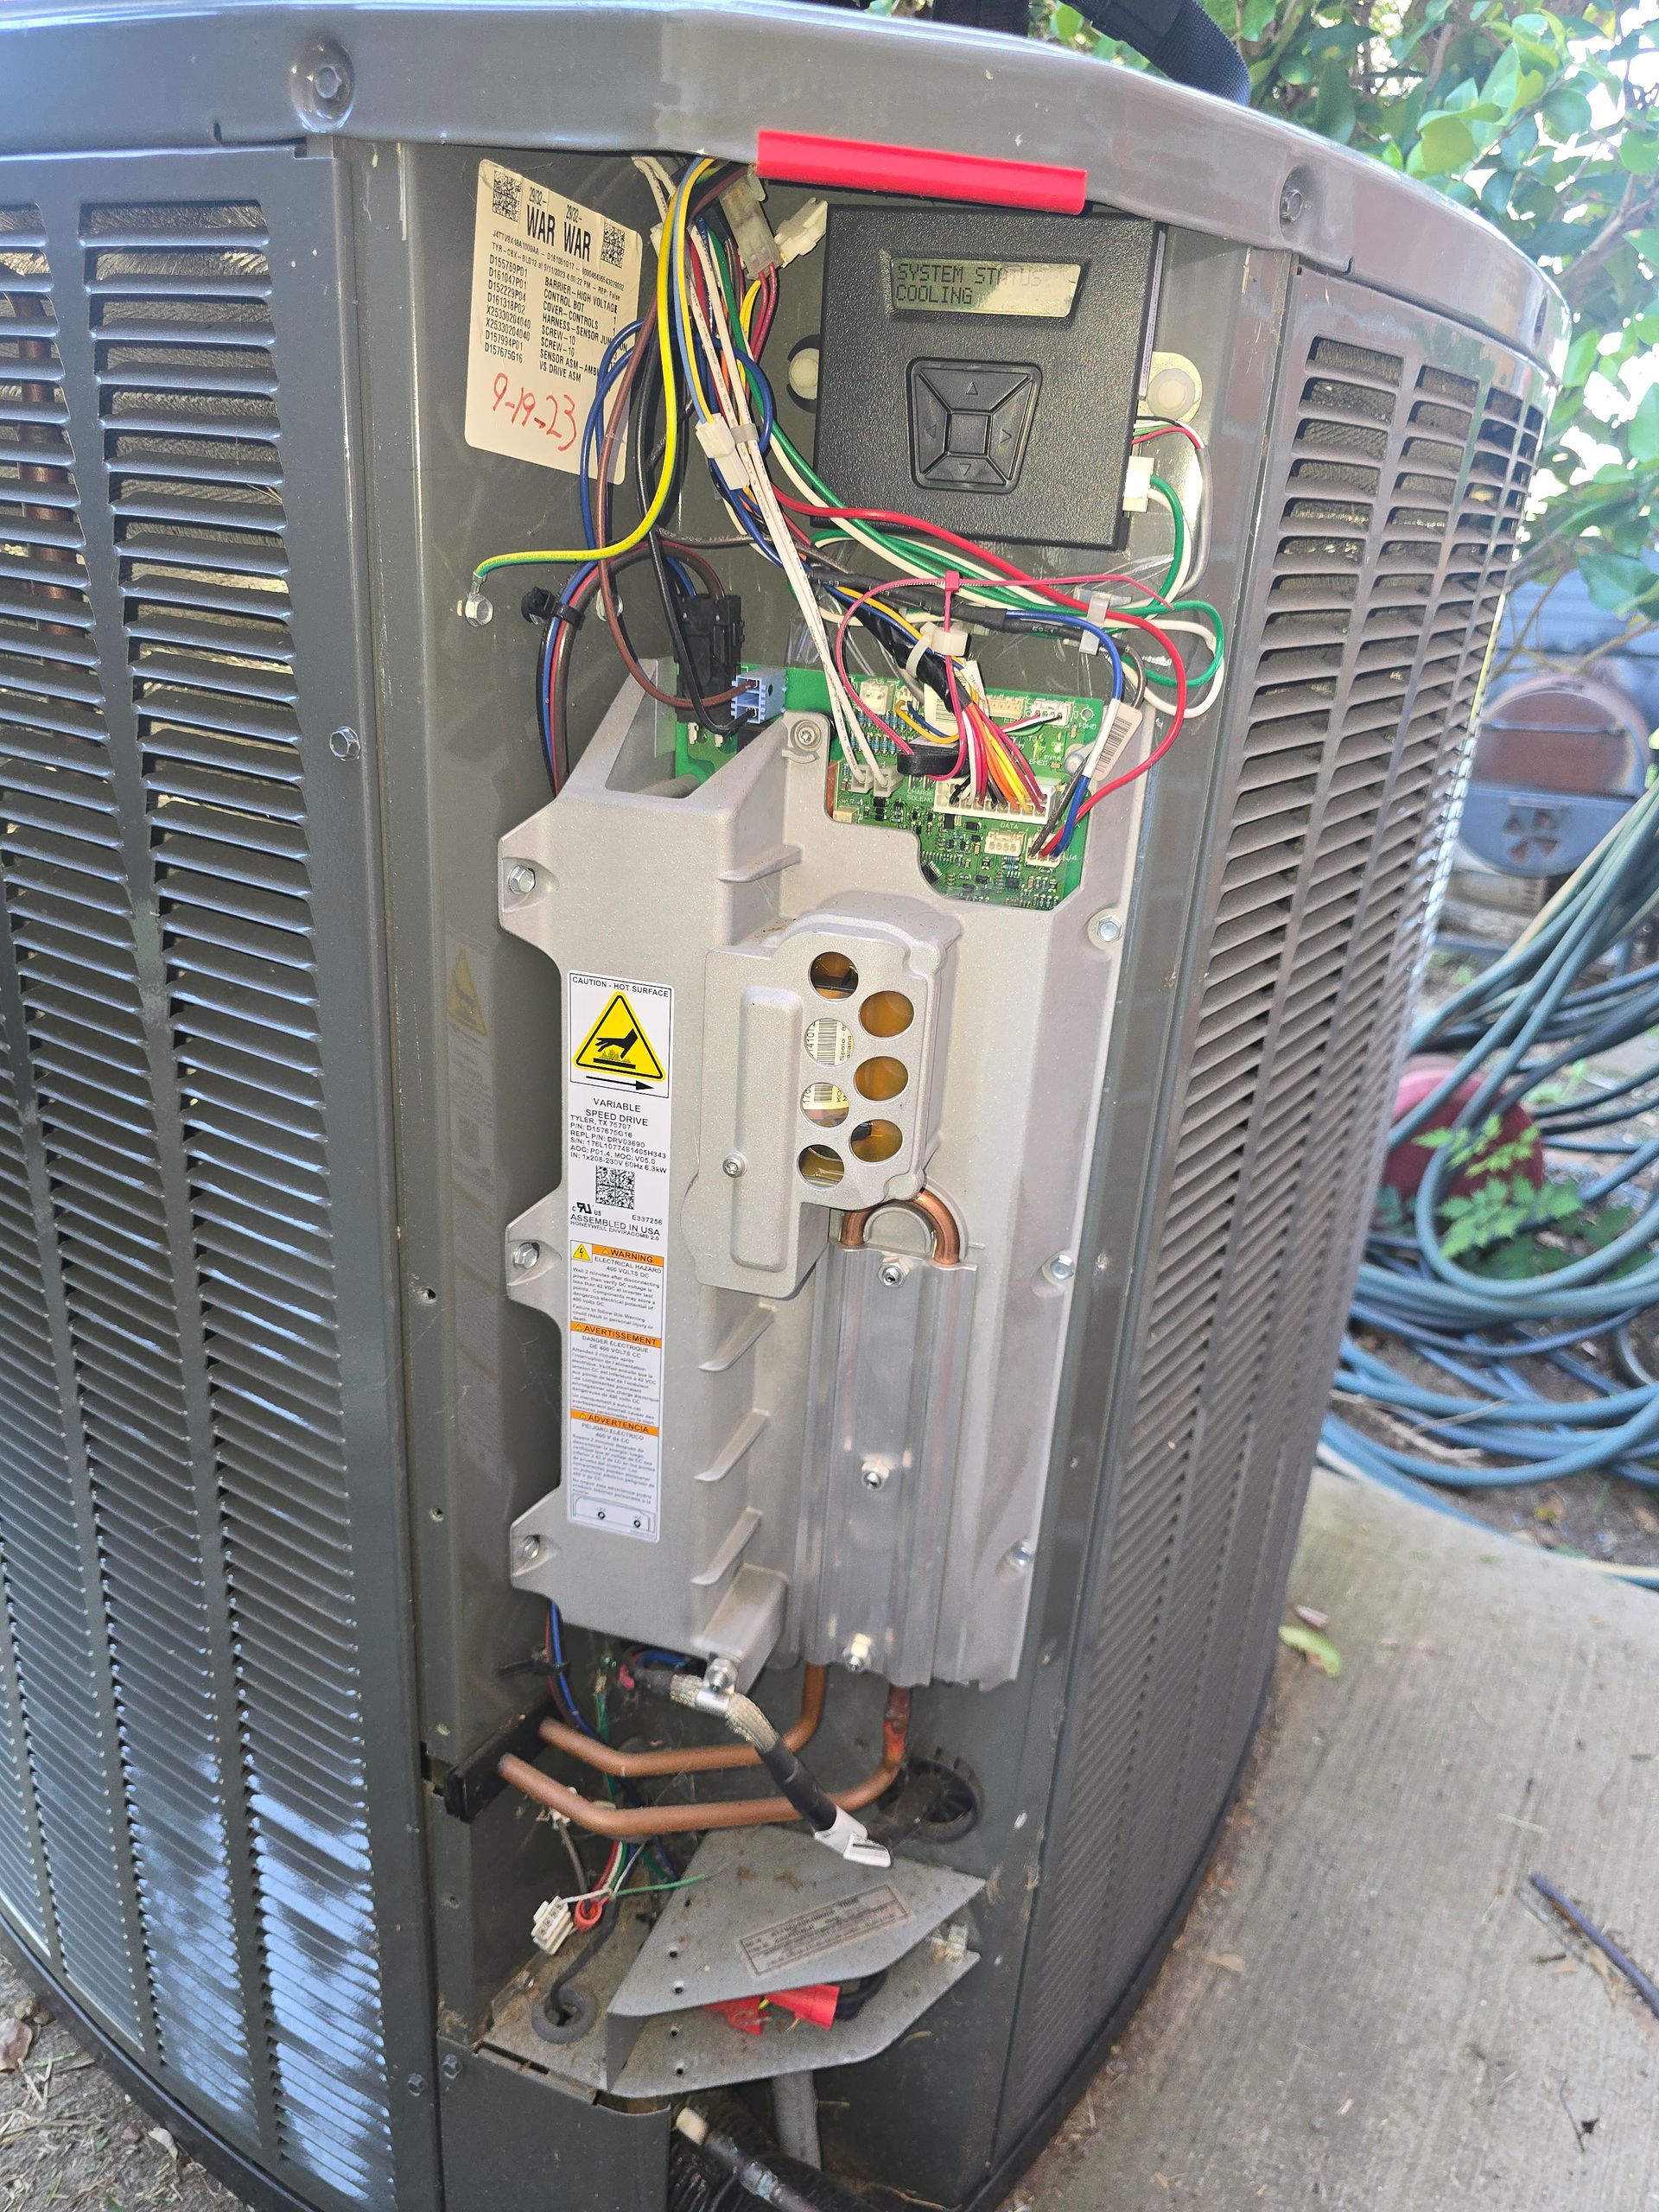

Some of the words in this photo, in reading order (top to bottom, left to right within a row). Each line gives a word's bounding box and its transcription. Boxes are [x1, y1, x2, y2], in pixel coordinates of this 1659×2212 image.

[524, 203, 556, 246] WAR
[562, 220, 591, 262] WAR
[489, 253, 527, 278] D155769P01
[897, 264, 963, 283] SYSTEM
[975, 267, 1042, 286] STATUS
[488, 266, 526, 290] D161047P01
[487, 278, 525, 302] D152229P04
[896, 284, 972, 304] COOLING
[543, 288, 571, 308] CONTROL
[573, 300, 584, 313] BOT
[486, 303, 531, 330] X25330204040
[485, 315, 530, 341] X25330204040
[539, 347, 564, 365] SENSOR
[538, 360, 547, 372] VS
[548, 363, 567, 378] DRIVE
[568, 370, 581, 383] ASM
[492, 372, 577, 452] 9-19-23
[572, 976, 607, 988] CAUTION
[613, 982, 628, 991] HOT
[632, 985, 668, 997] SURFACE
[593, 1097, 640, 1112] VARIABLE
[570, 1114, 596, 1125] TYLER,
[609, 1121, 631, 1130] 75707
[585, 1108, 616, 1121] SPEED
[619, 1114, 648, 1126] DRIVE
[570, 1129, 589, 1138] REPL
[591, 1133, 605, 1141] P/N:
[607, 1135, 645, 1148] DRV03690
[570, 1144, 588, 1153] AOC:
[614, 1152, 633, 1160] MOC:
[635, 1155, 655, 1165] V05.0
[625, 1160, 642, 1170] 60Hz
[644, 1164, 666, 1174] 6.3kW
[569, 1220, 607, 1231] HONEYWELL
[570, 1212, 626, 1230] ASSEMBLED
[640, 1225, 659, 1236] USA
[632, 1214, 662, 1225] E337256
[594, 1255, 632, 1268] ELECTRICAL
[635, 1264, 661, 1274] HAZARD
[611, 1249, 652, 1263] WARNING
[619, 1268, 638, 1276] VOLTS
[582, 1334, 607, 1344] DANGER
[583, 1324, 656, 1346] AVERTISSEMENT
[588, 1414, 649, 1433] ADVERTENCIA
